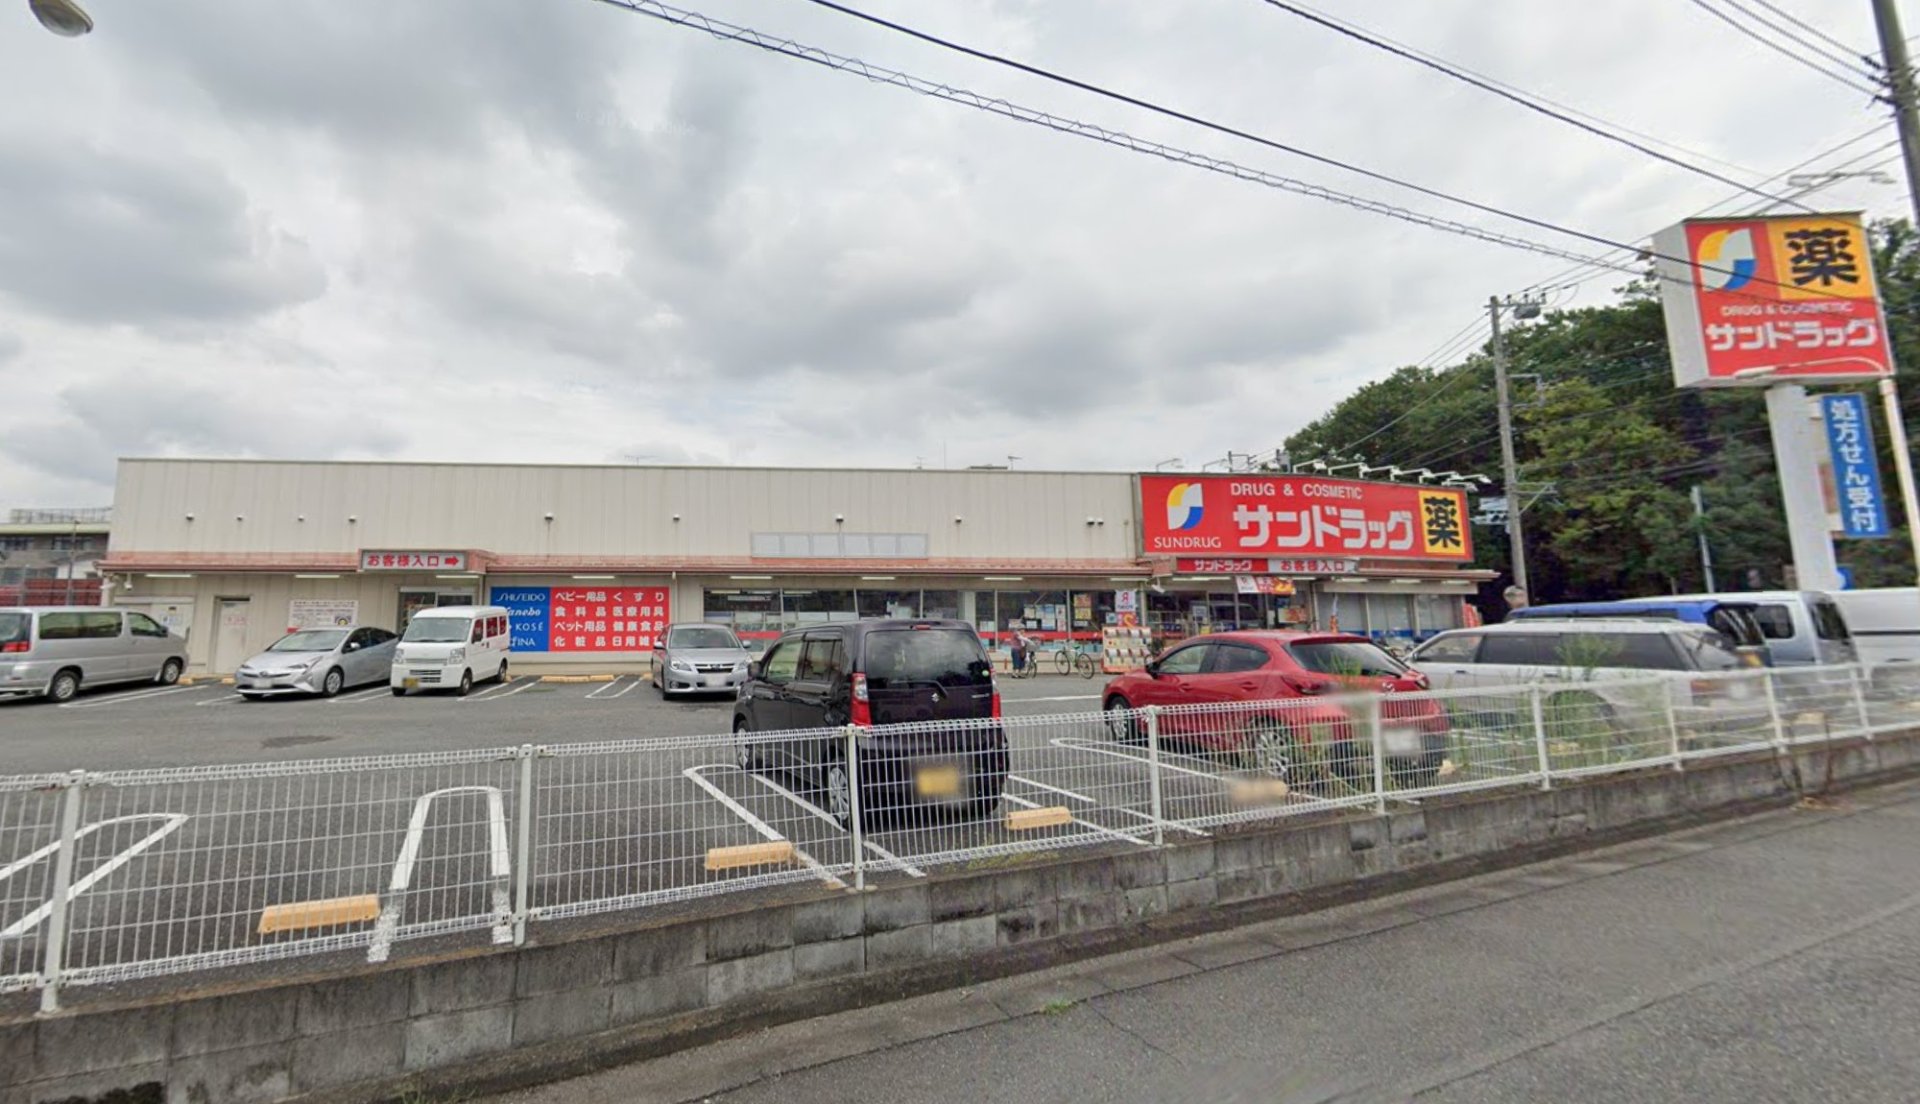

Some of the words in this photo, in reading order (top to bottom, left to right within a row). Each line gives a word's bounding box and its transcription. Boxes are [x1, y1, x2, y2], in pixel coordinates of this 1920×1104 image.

[1783, 228, 1859, 286] 薬
[1721, 305, 1763, 316] DRUG
[1766, 304, 1777, 315] &
[1705, 317, 1878, 350] サンドラッグ
[1830, 400, 1878, 532] 処方せん受付
[1230, 483, 1275, 496] DRUG
[1283, 483, 1294, 496] &
[1302, 484, 1362, 499] COSMETIC
[1233, 504, 1413, 550] サンドラッグ
[1424, 496, 1462, 548] 薬
[1154, 536, 1221, 548] SUNDRUG
[367, 554, 439, 567] お客様入口
[1194, 560, 1252, 571] サンドラッグ
[1280, 560, 1345, 571] お客様入口
[497, 592, 546, 601] SHISEIDO
[555, 592, 606, 602] ベビー用品
[555, 607, 606, 617] 食料品
[613, 607, 664, 617] 医療用具
[555, 622, 606, 632] ペット用品
[613, 622, 664, 632] 健康食品
[554, 636, 606, 647] 化粧品
[612, 636, 659, 647] 日用雑
